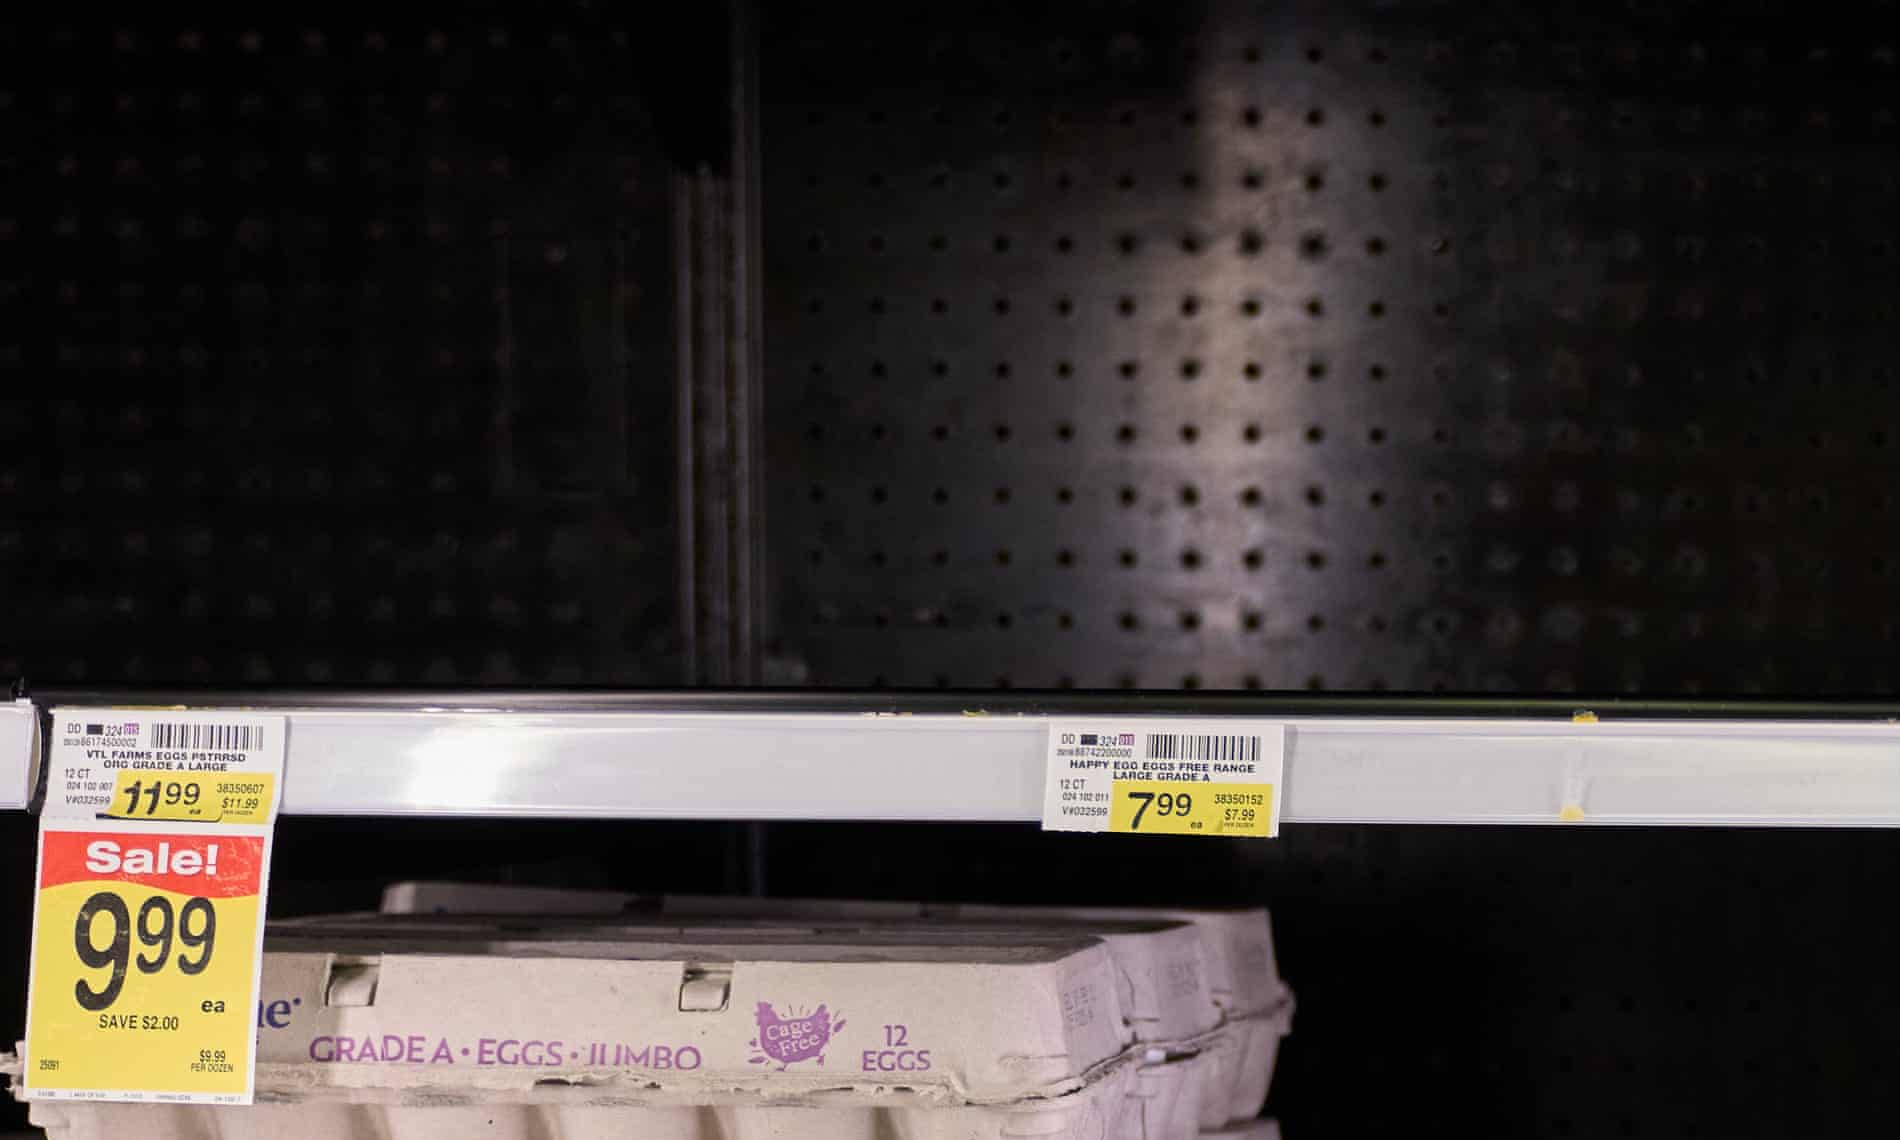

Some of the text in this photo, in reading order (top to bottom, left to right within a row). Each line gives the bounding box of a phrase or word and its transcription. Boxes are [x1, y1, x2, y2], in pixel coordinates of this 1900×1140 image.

[87, 750, 106, 760] VTL
[111, 751, 152, 761] FARMS
[156, 751, 187, 761] EGGS
[103, 760, 228, 772] ORG GRADE A LARGE
[1070, 760, 1109, 769] HAPPY
[1143, 762, 1175, 771] EGGS
[1179, 763, 1209, 772] FREE
[1213, 763, 1256, 773] RANGE
[65, 769, 90, 779] 12 CT
[1113, 771, 1210, 782] LARGE GRADE A
[1060, 779, 1086, 790] 12 CT
[222, 797, 258, 809] $11.99
[1224, 808, 1255, 821] $7.99
[85, 841, 219, 875] Sale!
[201, 1000, 225, 1013] ea
[99, 1015, 179, 1031] SAVE $2.00
[766, 1020, 814, 1040] Cage
[884, 1024, 909, 1047] 12
[778, 1034, 820, 1056] Free
[199, 1050, 226, 1063] $9.99
[309, 1036, 702, 1071] GRADE A EGGS JUMBO
[862, 1050, 931, 1072] EGGS
[191, 1063, 234, 1073] PER DOZEN
